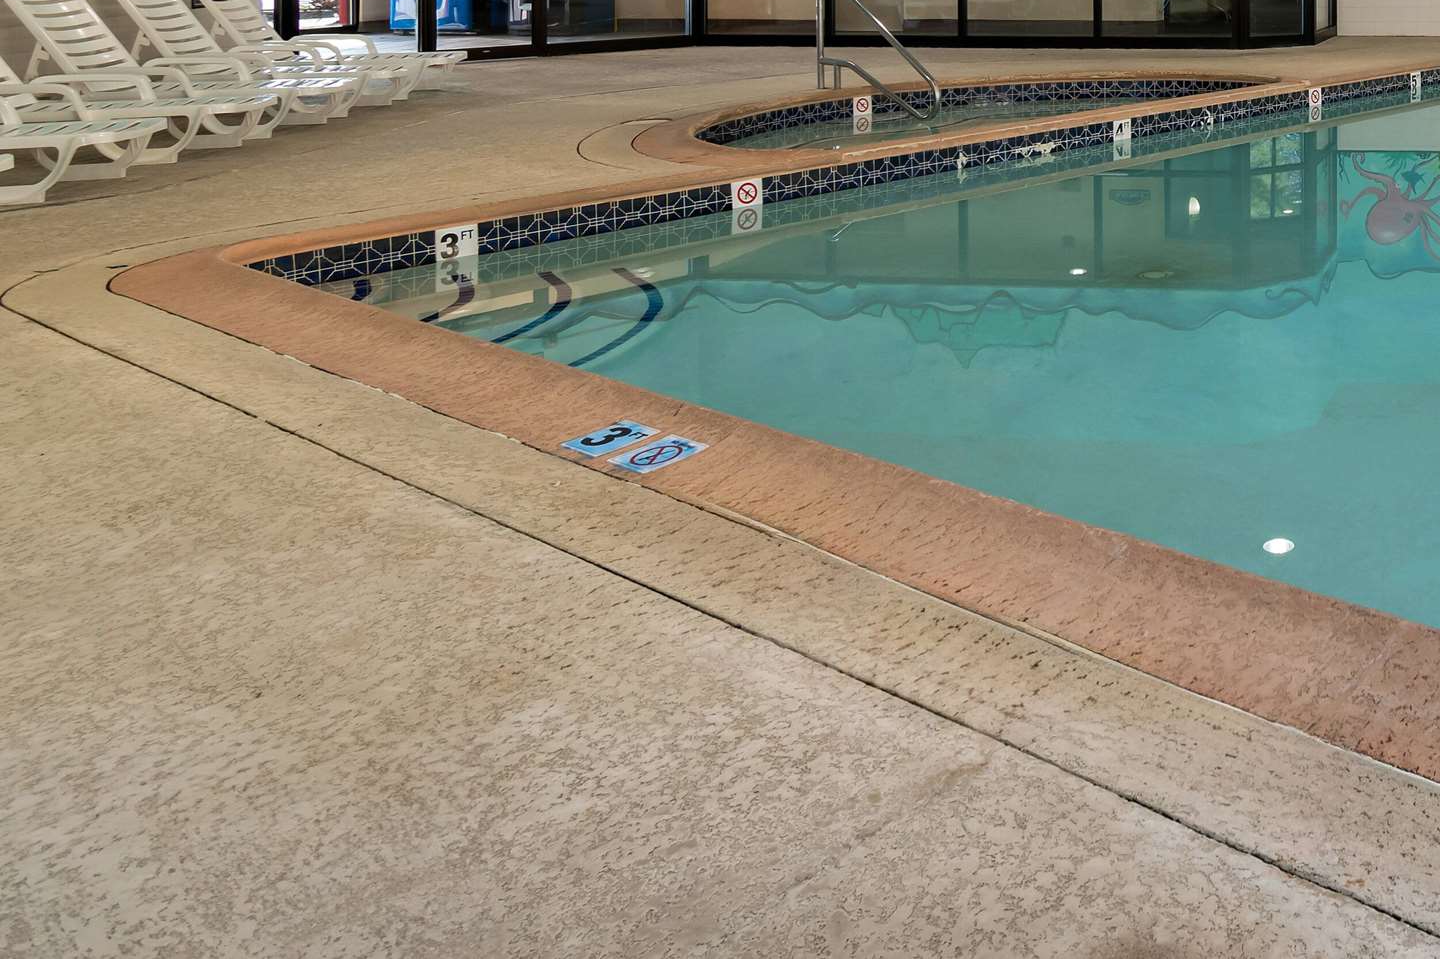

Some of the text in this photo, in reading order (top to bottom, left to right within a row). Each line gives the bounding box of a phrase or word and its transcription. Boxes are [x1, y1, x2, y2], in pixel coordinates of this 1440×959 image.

[440, 229, 474, 259] 3 FT
[580, 427, 649, 446] 3 FT
